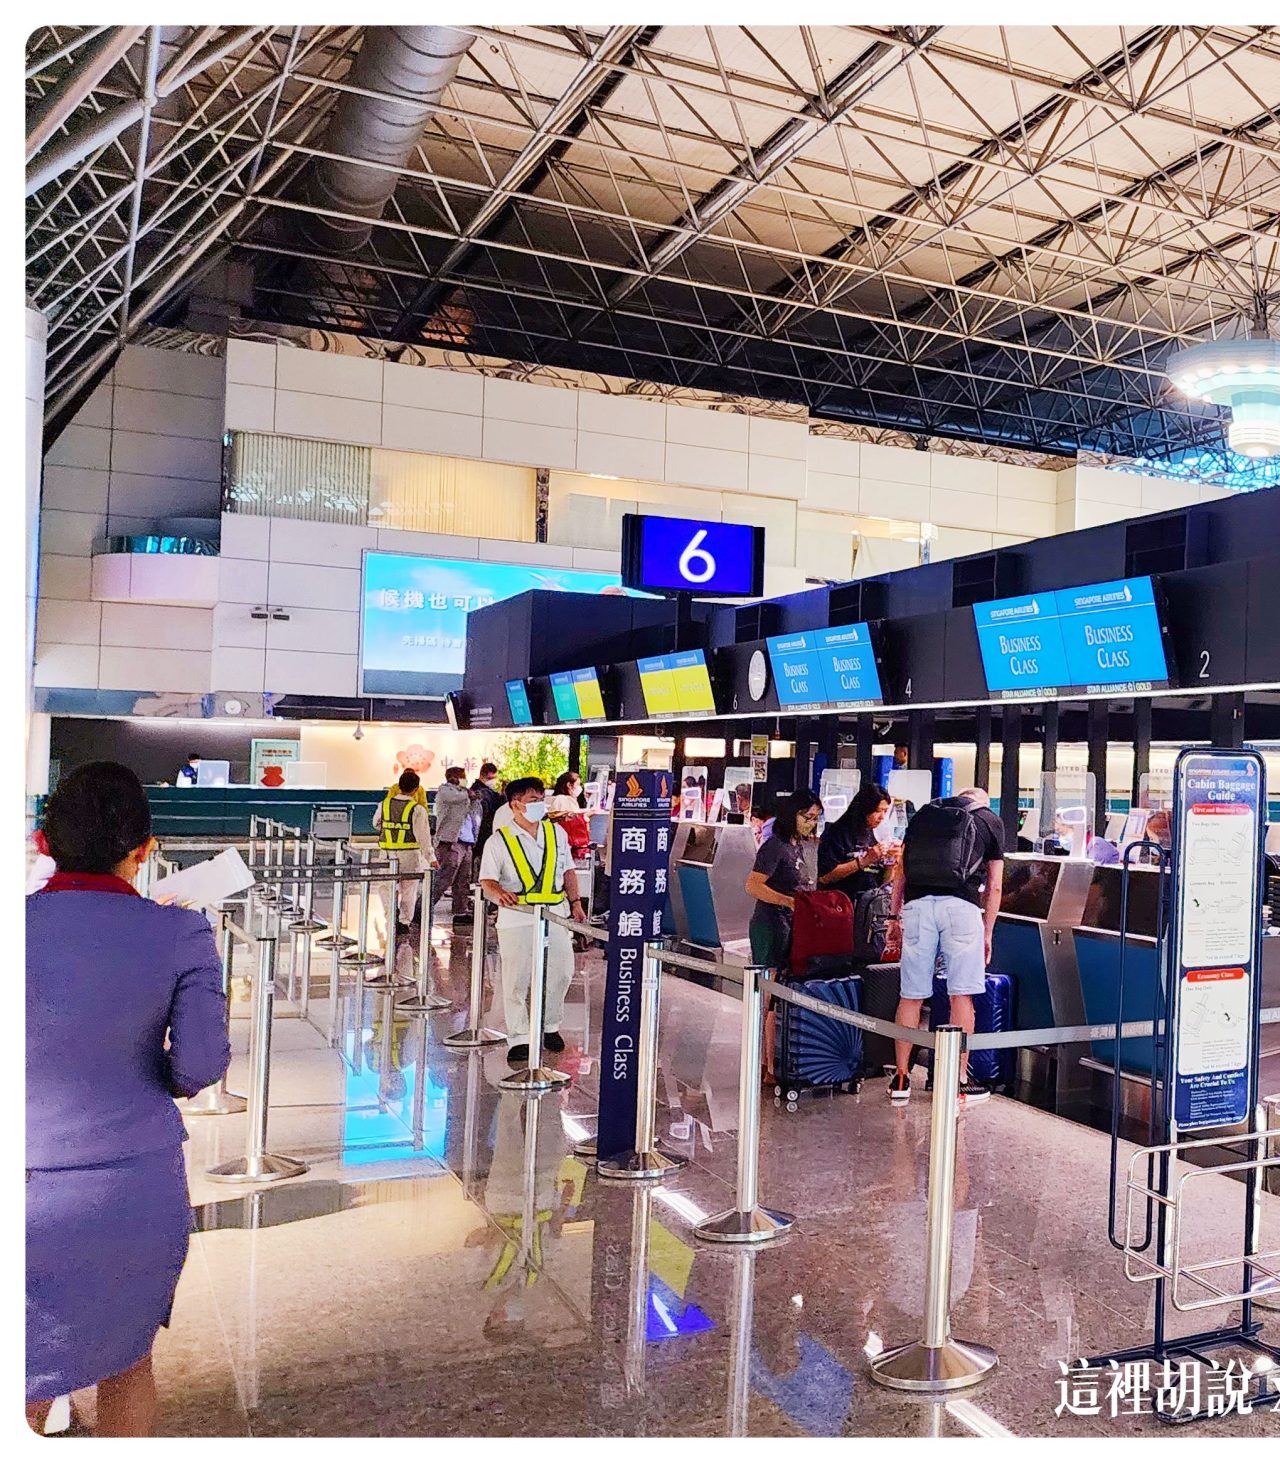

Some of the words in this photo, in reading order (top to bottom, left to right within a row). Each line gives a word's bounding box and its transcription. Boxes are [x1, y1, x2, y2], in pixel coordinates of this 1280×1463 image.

[679, 529, 716, 583] 6
[1198, 650, 1210, 678] 2
[733, 694, 738, 710] 6
[905, 678, 912, 698] 4
[1187, 778, 1216, 789] Cabin
[1218, 779, 1256, 792] Baggage
[1207, 790, 1236, 801] Guide
[618, 827, 648, 937] 商務艙
[652, 827, 670, 936] 商務艙
[615, 948, 638, 1023] Business
[613, 1034, 633, 1080] Class
